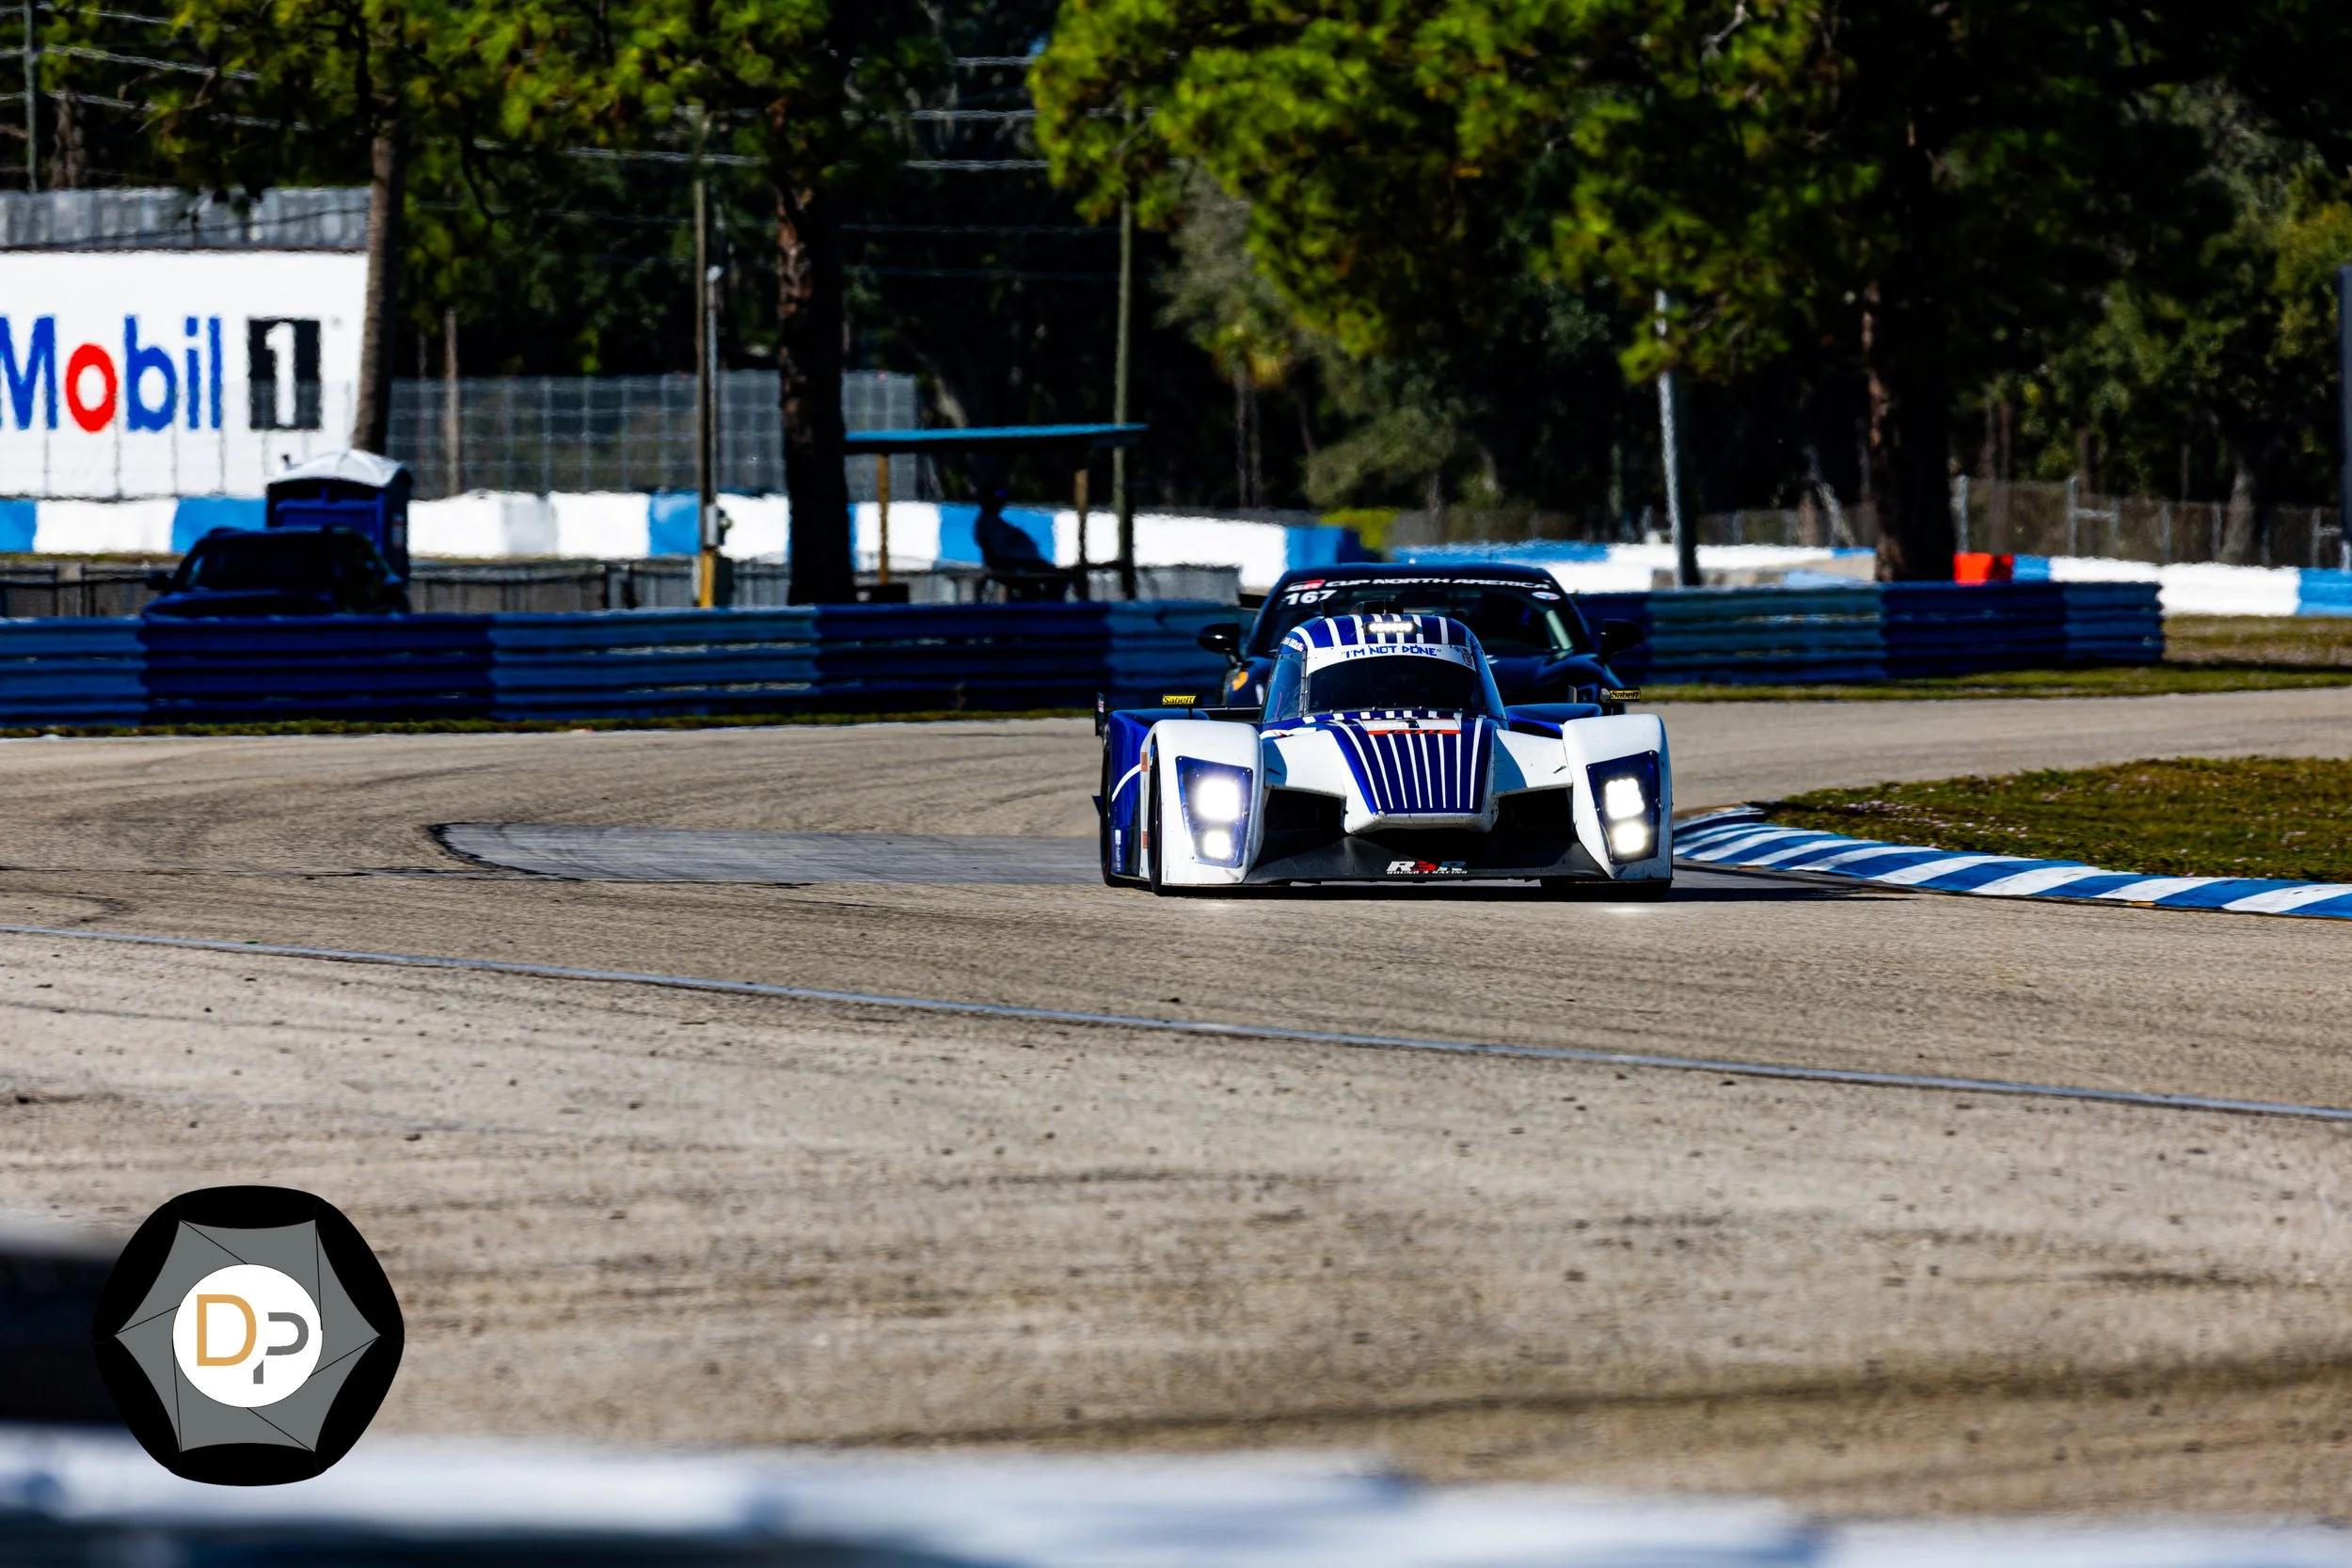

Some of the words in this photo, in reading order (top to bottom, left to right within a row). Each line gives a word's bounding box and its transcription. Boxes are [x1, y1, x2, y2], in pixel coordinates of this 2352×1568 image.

[0, 313, 222, 434] Mobil
[1452, 578, 1551, 590] AMERICA
[1284, 589, 1338, 605] 167
[1368, 644, 1397, 656] NOT
[1611, 690, 1640, 699] Sabelt
